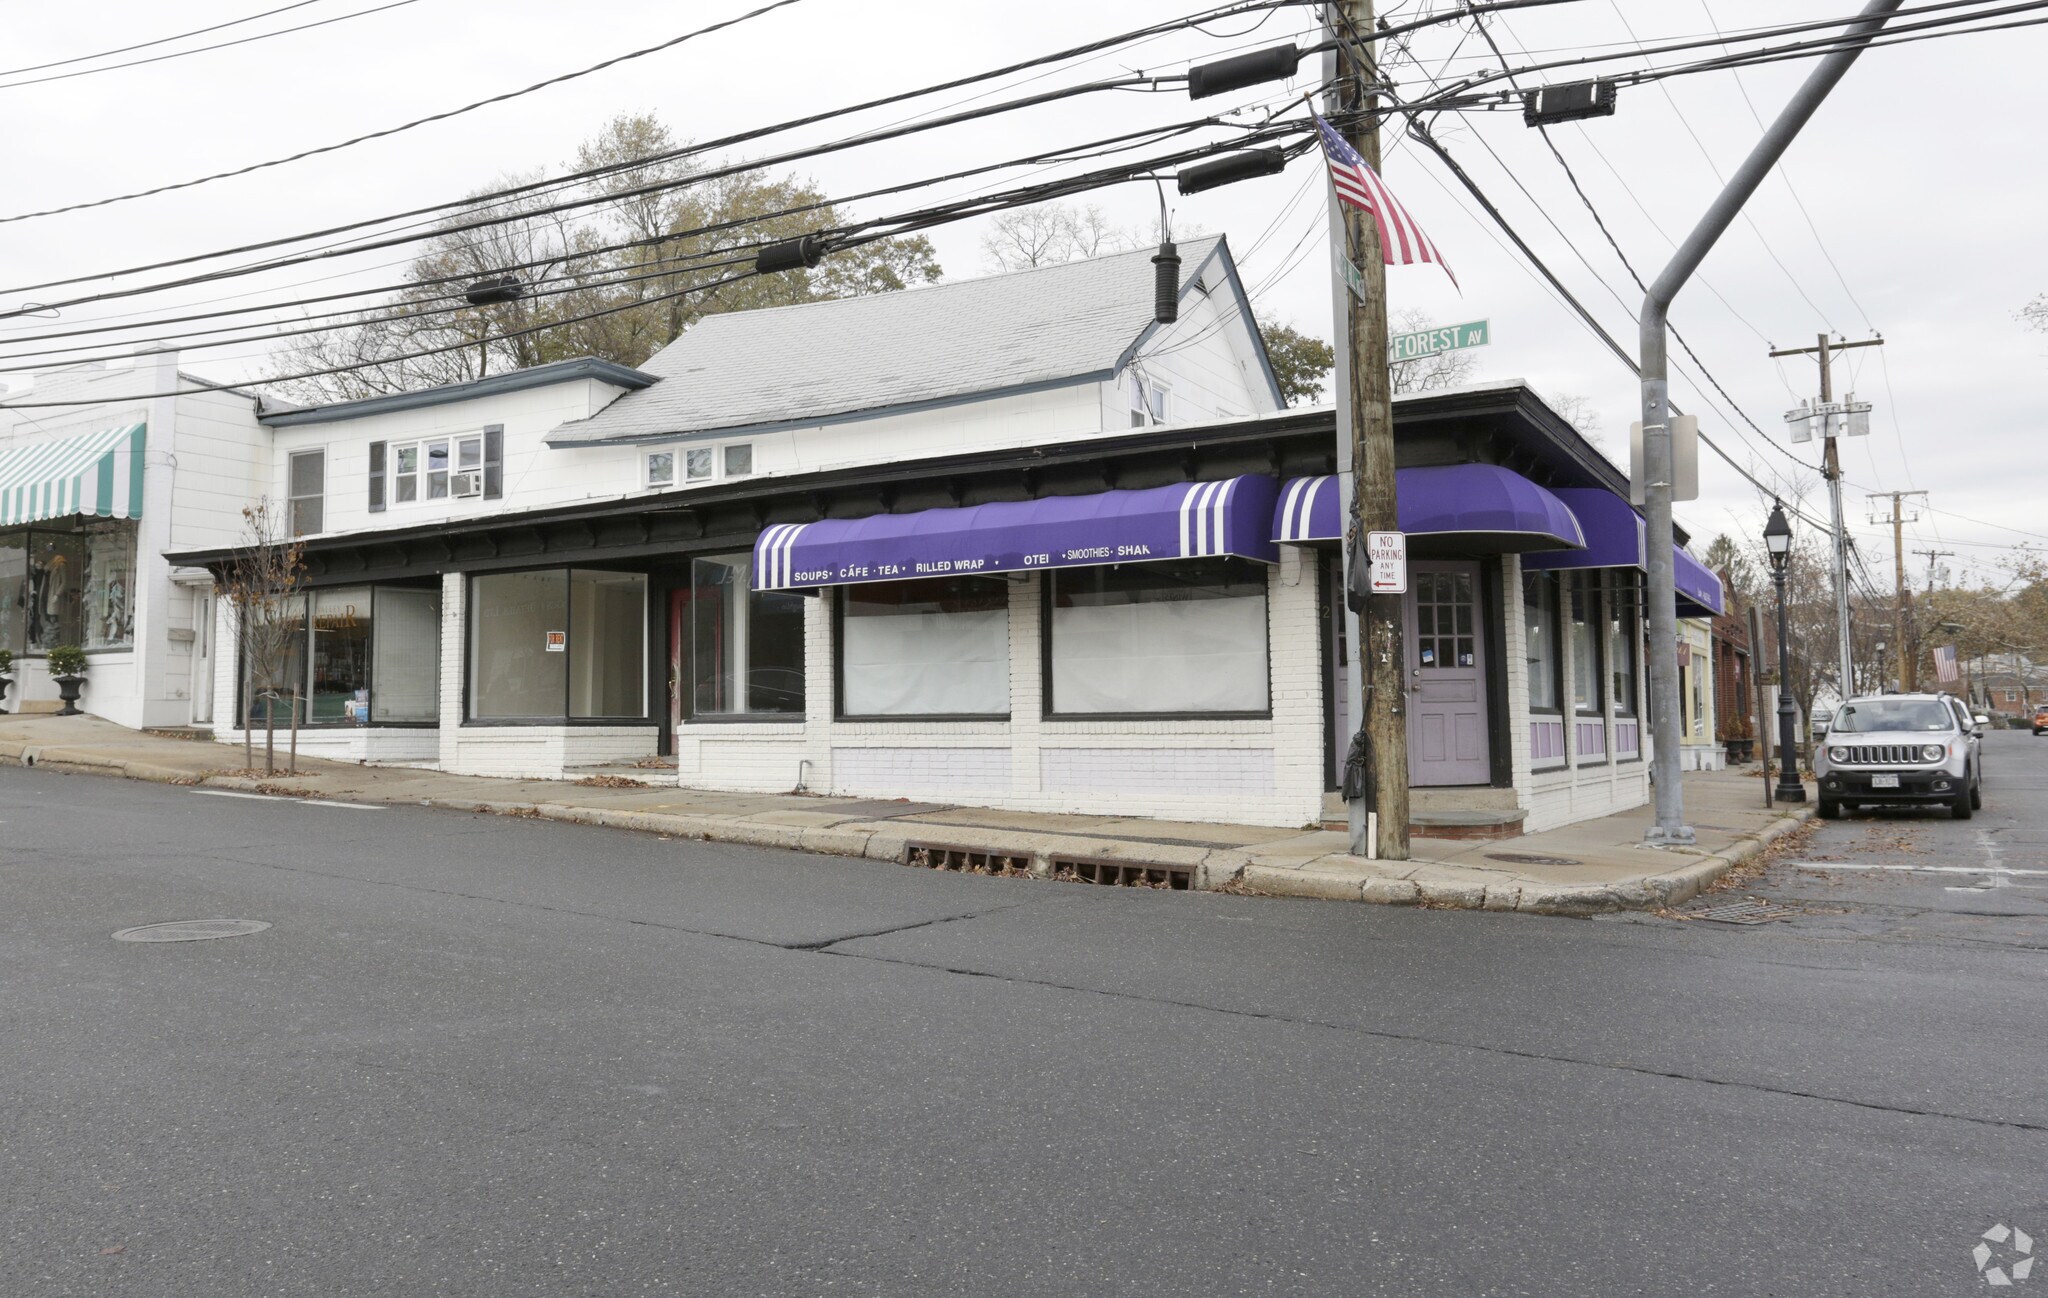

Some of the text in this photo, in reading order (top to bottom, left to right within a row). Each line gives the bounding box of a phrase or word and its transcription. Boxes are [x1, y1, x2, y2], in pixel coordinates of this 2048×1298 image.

[1394, 327, 1482, 358] FOREST AV
[1379, 536, 1394, 548] NO
[1371, 549, 1403, 560] PARKING
[794, 570, 829, 581] SOUPS
[878, 565, 899, 575] TEA
[916, 561, 951, 573] RILLED
[954, 559, 985, 570] WRAP
[1067, 547, 1110, 560] SMOOTHIES
[1380, 562, 1395, 570] ANY
[1380, 572, 1396, 580] TIME
[312, 604, 357, 629] REPAIR
